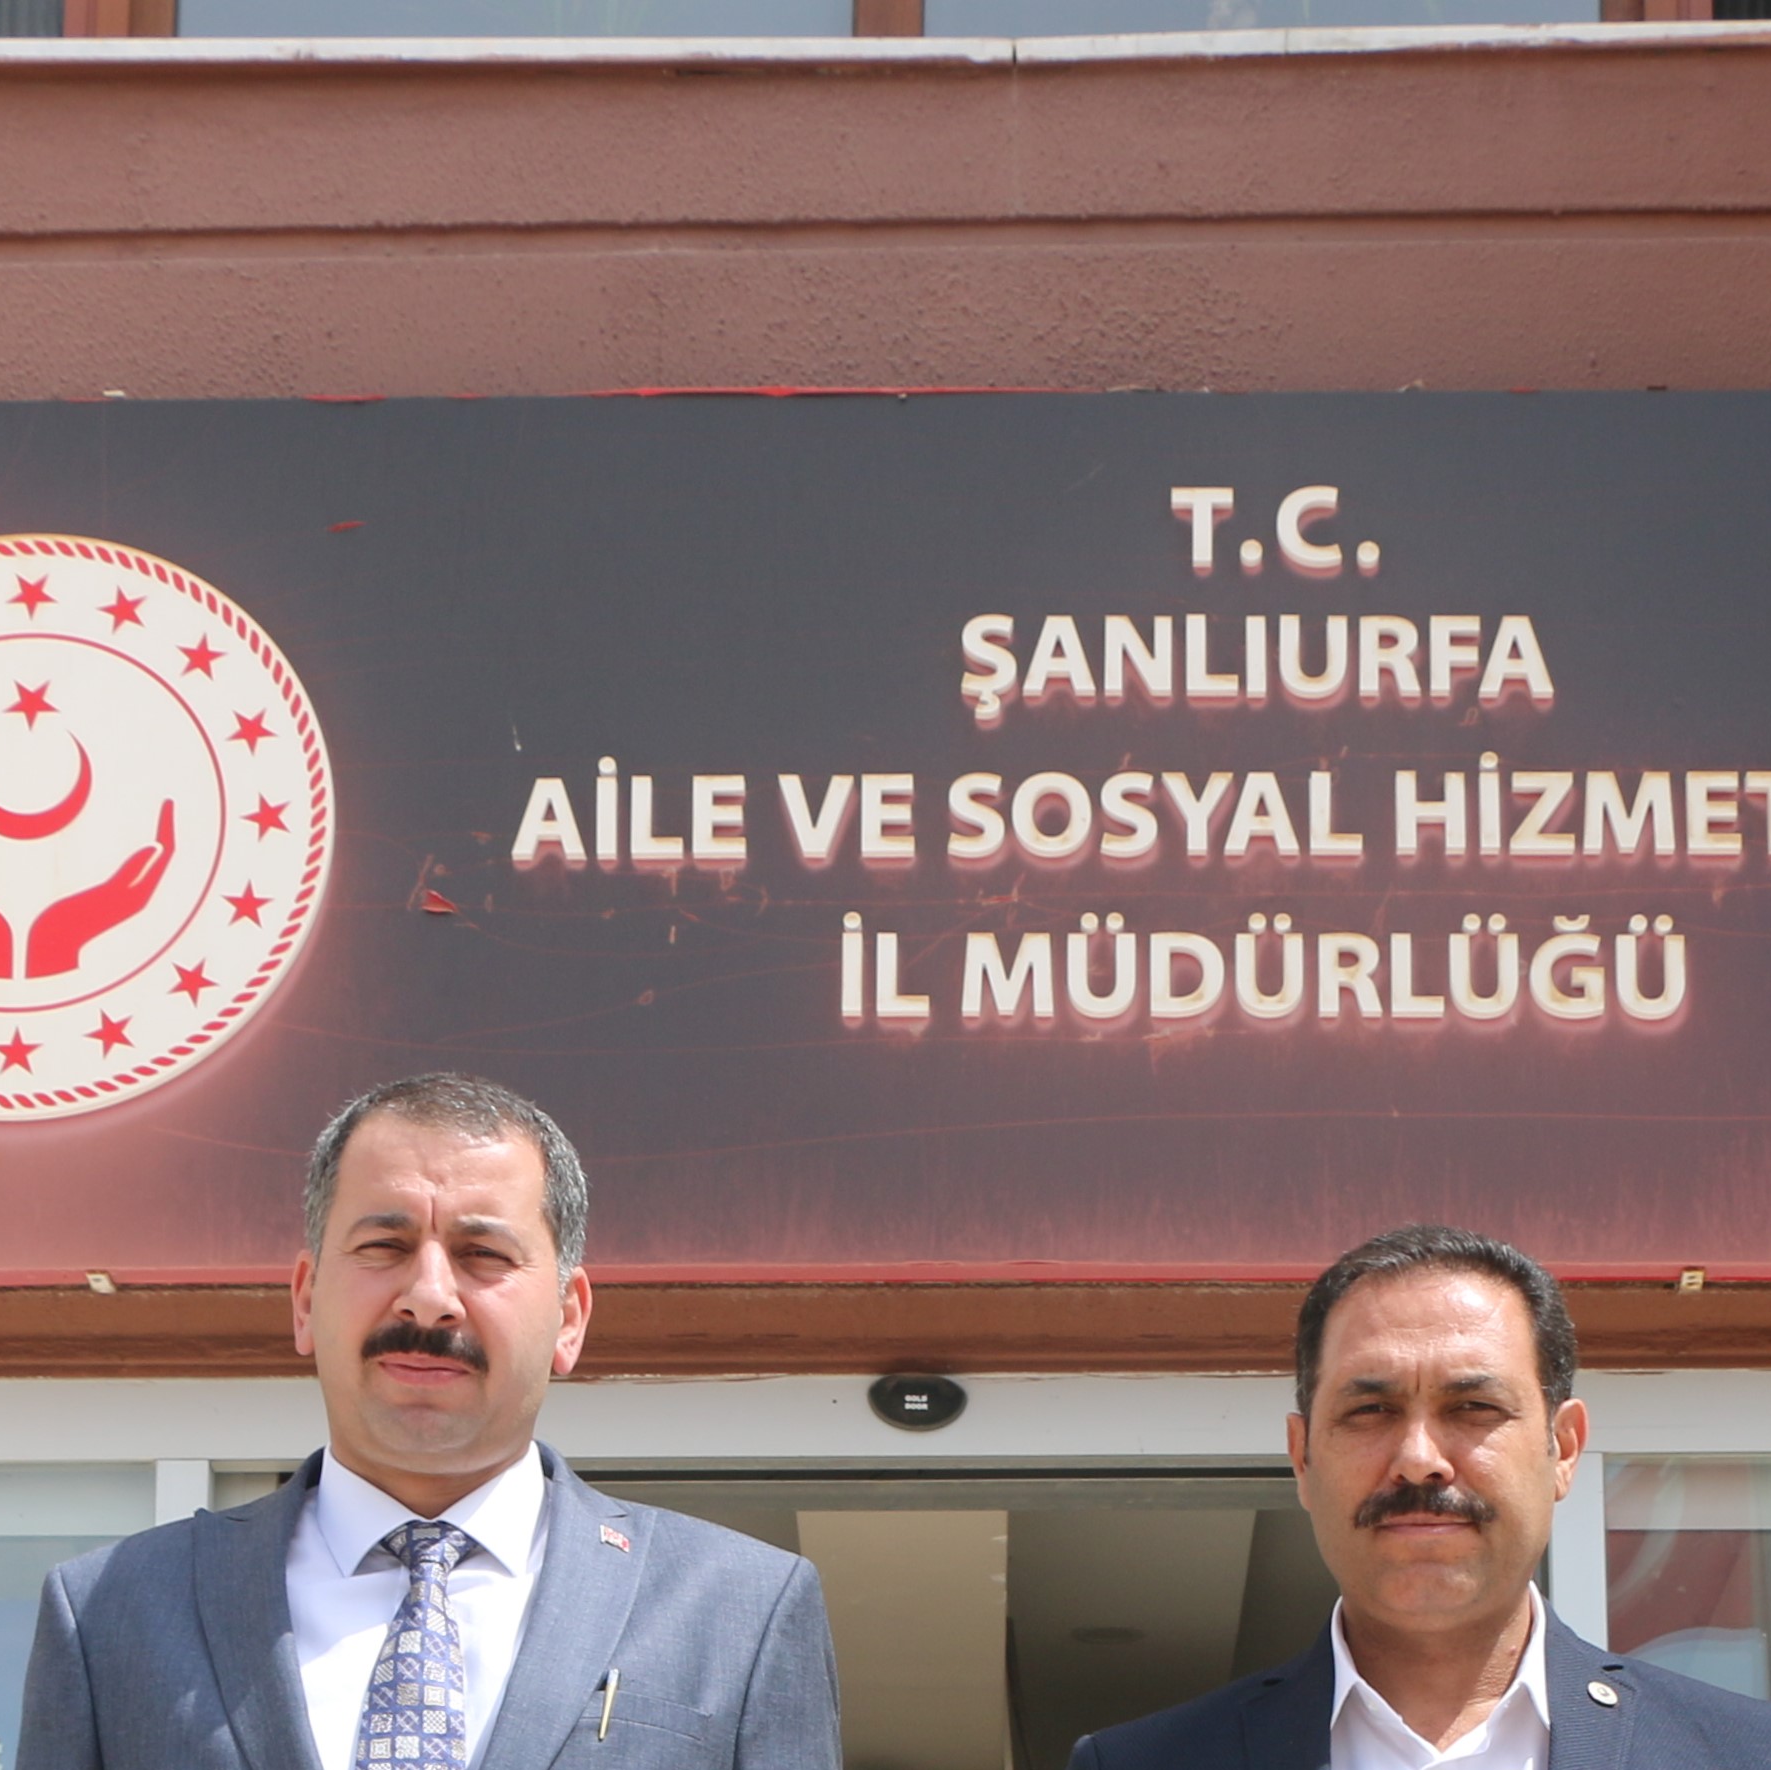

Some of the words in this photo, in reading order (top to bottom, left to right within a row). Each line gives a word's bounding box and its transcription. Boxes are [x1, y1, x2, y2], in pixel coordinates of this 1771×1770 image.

[1171, 486, 1381, 569] T.C.
[961, 614, 1554, 722] ŞANLIURFA
[511, 756, 747, 863] AİLE
[779, 773, 916, 861] VE
[947, 770, 1364, 858] SOSYAL
[840, 911, 931, 1019] İL
[961, 912, 1687, 1022] MÜDÜRLÜĞÜ
